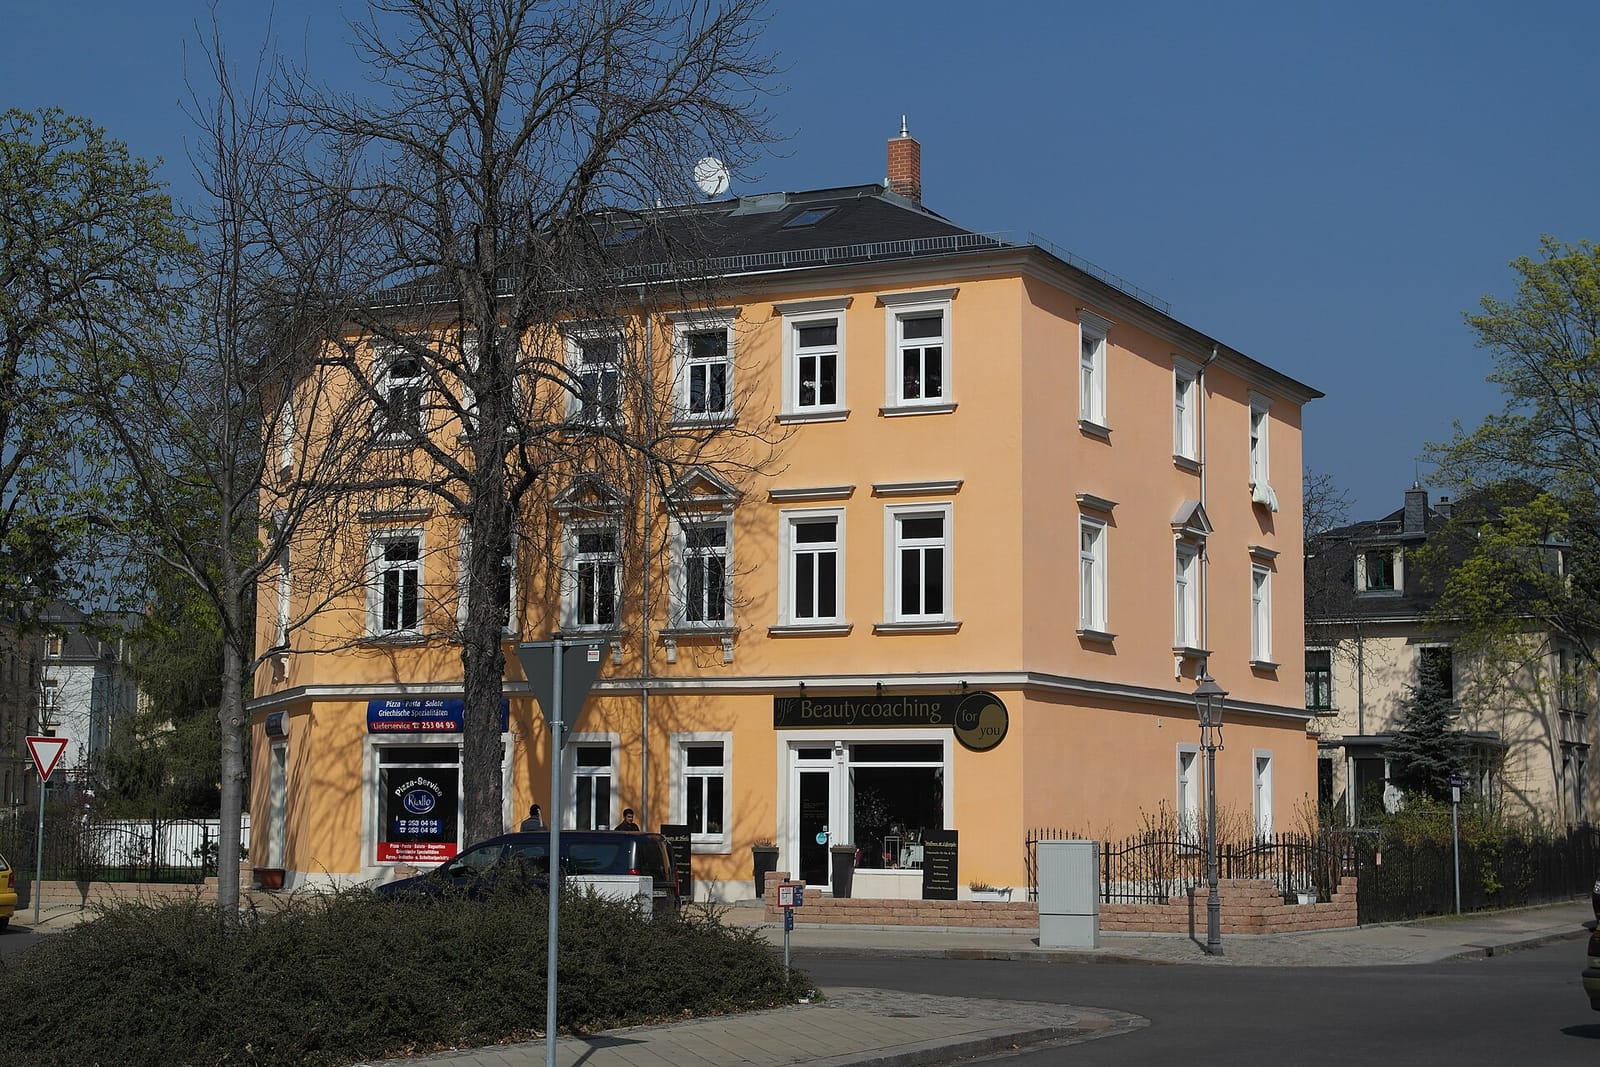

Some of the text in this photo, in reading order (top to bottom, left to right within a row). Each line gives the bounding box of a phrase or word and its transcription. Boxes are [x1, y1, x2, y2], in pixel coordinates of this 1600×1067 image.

[378, 709, 448, 717] Griechische Spezialitäten
[801, 697, 941, 724] Beautycoaching
[962, 709, 978, 722] for
[373, 721, 455, 730] Lieferservice 253 04 95
[980, 726, 1000, 740] you
[394, 776, 443, 797] Pizza-Service
